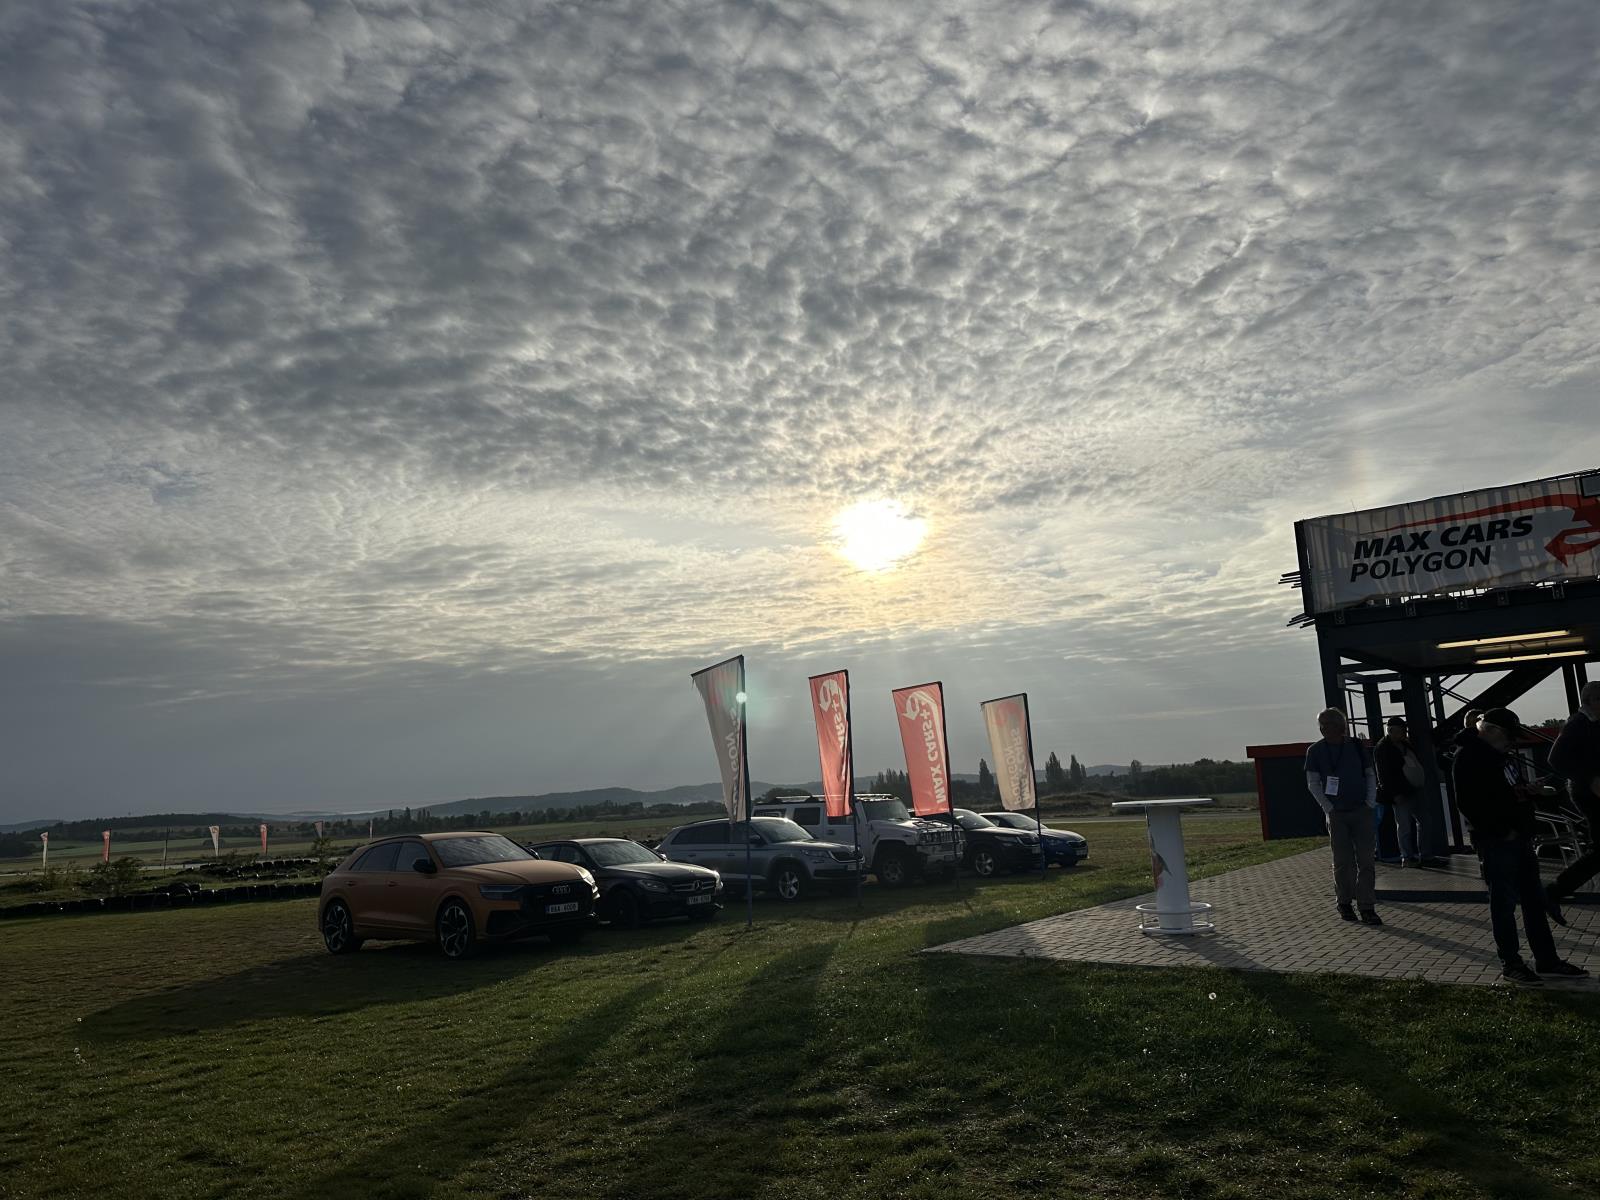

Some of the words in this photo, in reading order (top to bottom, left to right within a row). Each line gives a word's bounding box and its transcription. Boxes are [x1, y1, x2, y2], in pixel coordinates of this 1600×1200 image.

[1353, 530, 1432, 560] MAX
[1440, 515, 1533, 546] CARS
[1350, 545, 1491, 582] POLYGON
